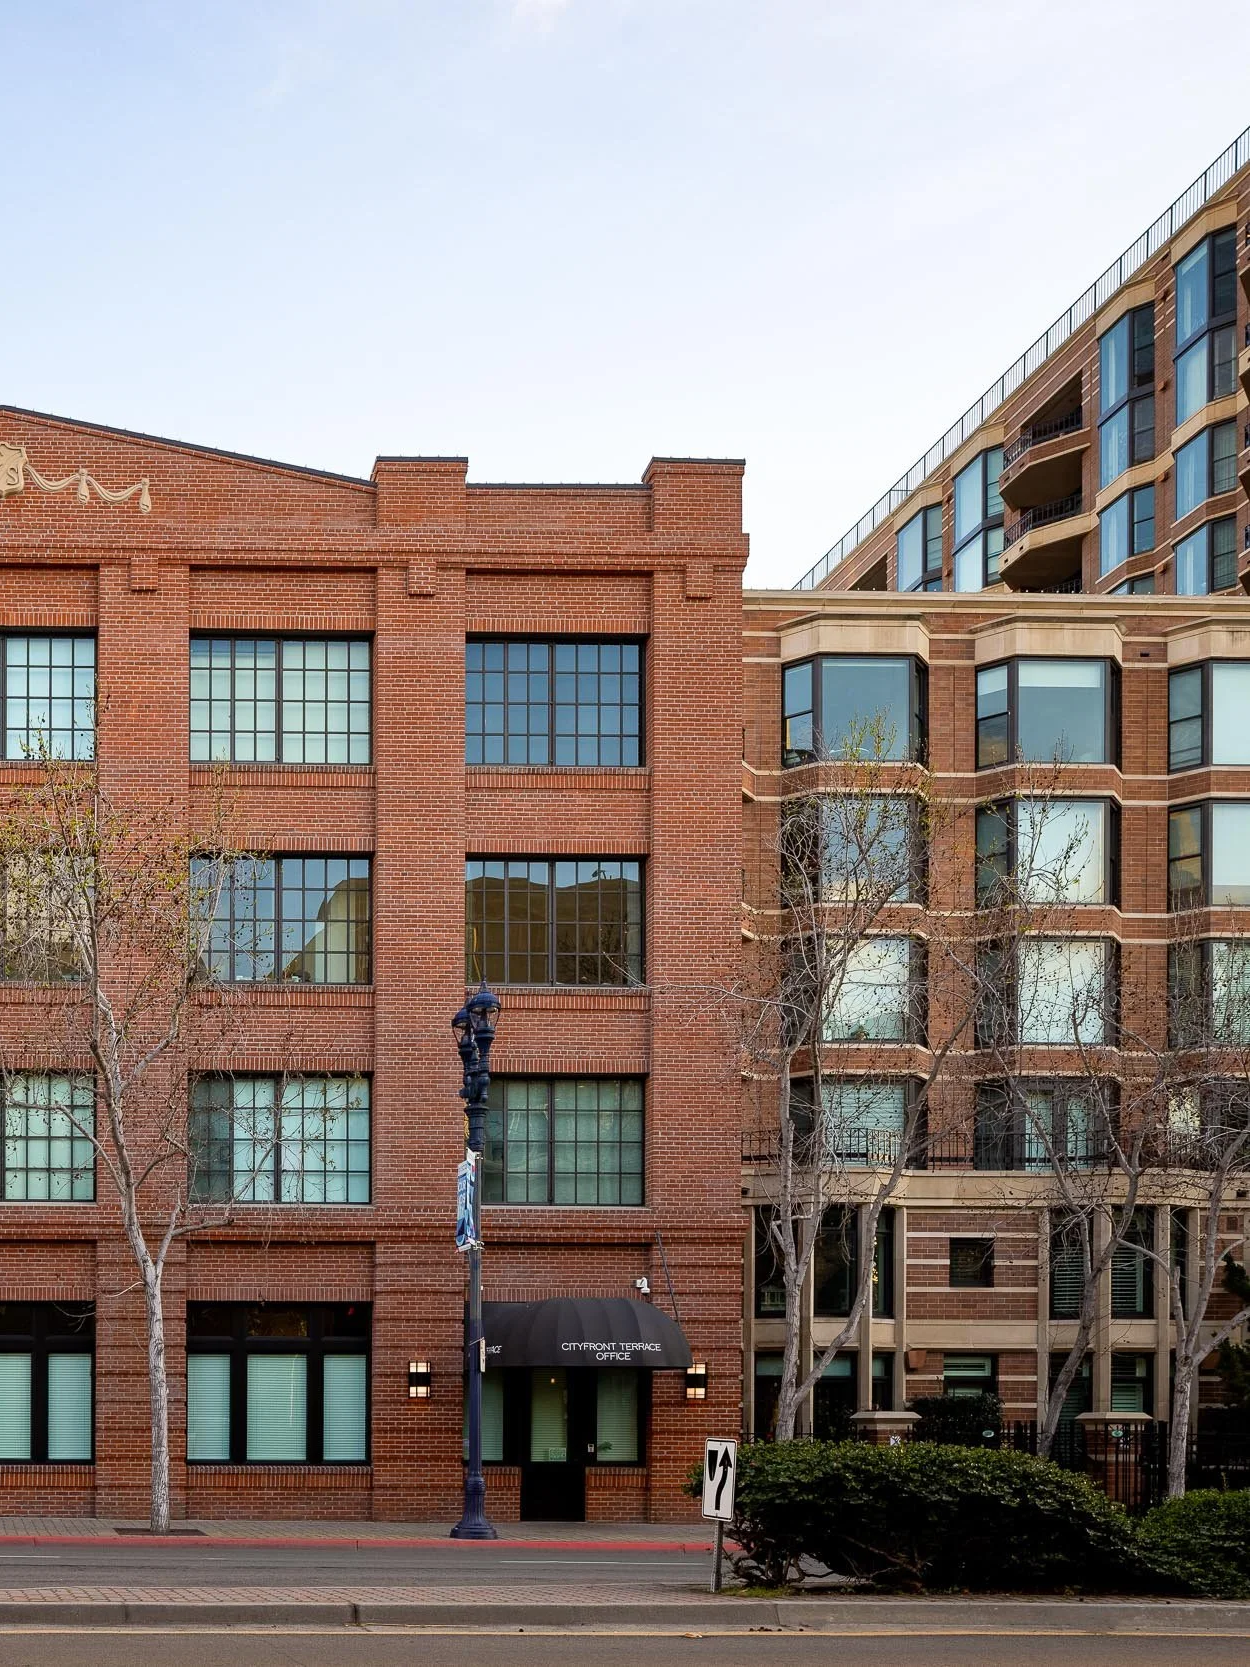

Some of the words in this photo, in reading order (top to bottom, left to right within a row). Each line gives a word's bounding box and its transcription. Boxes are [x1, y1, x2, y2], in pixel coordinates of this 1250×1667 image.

[6, 467, 19, 485] S
[561, 1342, 616, 1351] CITYFRONT
[619, 1342, 661, 1351] TERRACE
[596, 1352, 631, 1361] OFFICE
